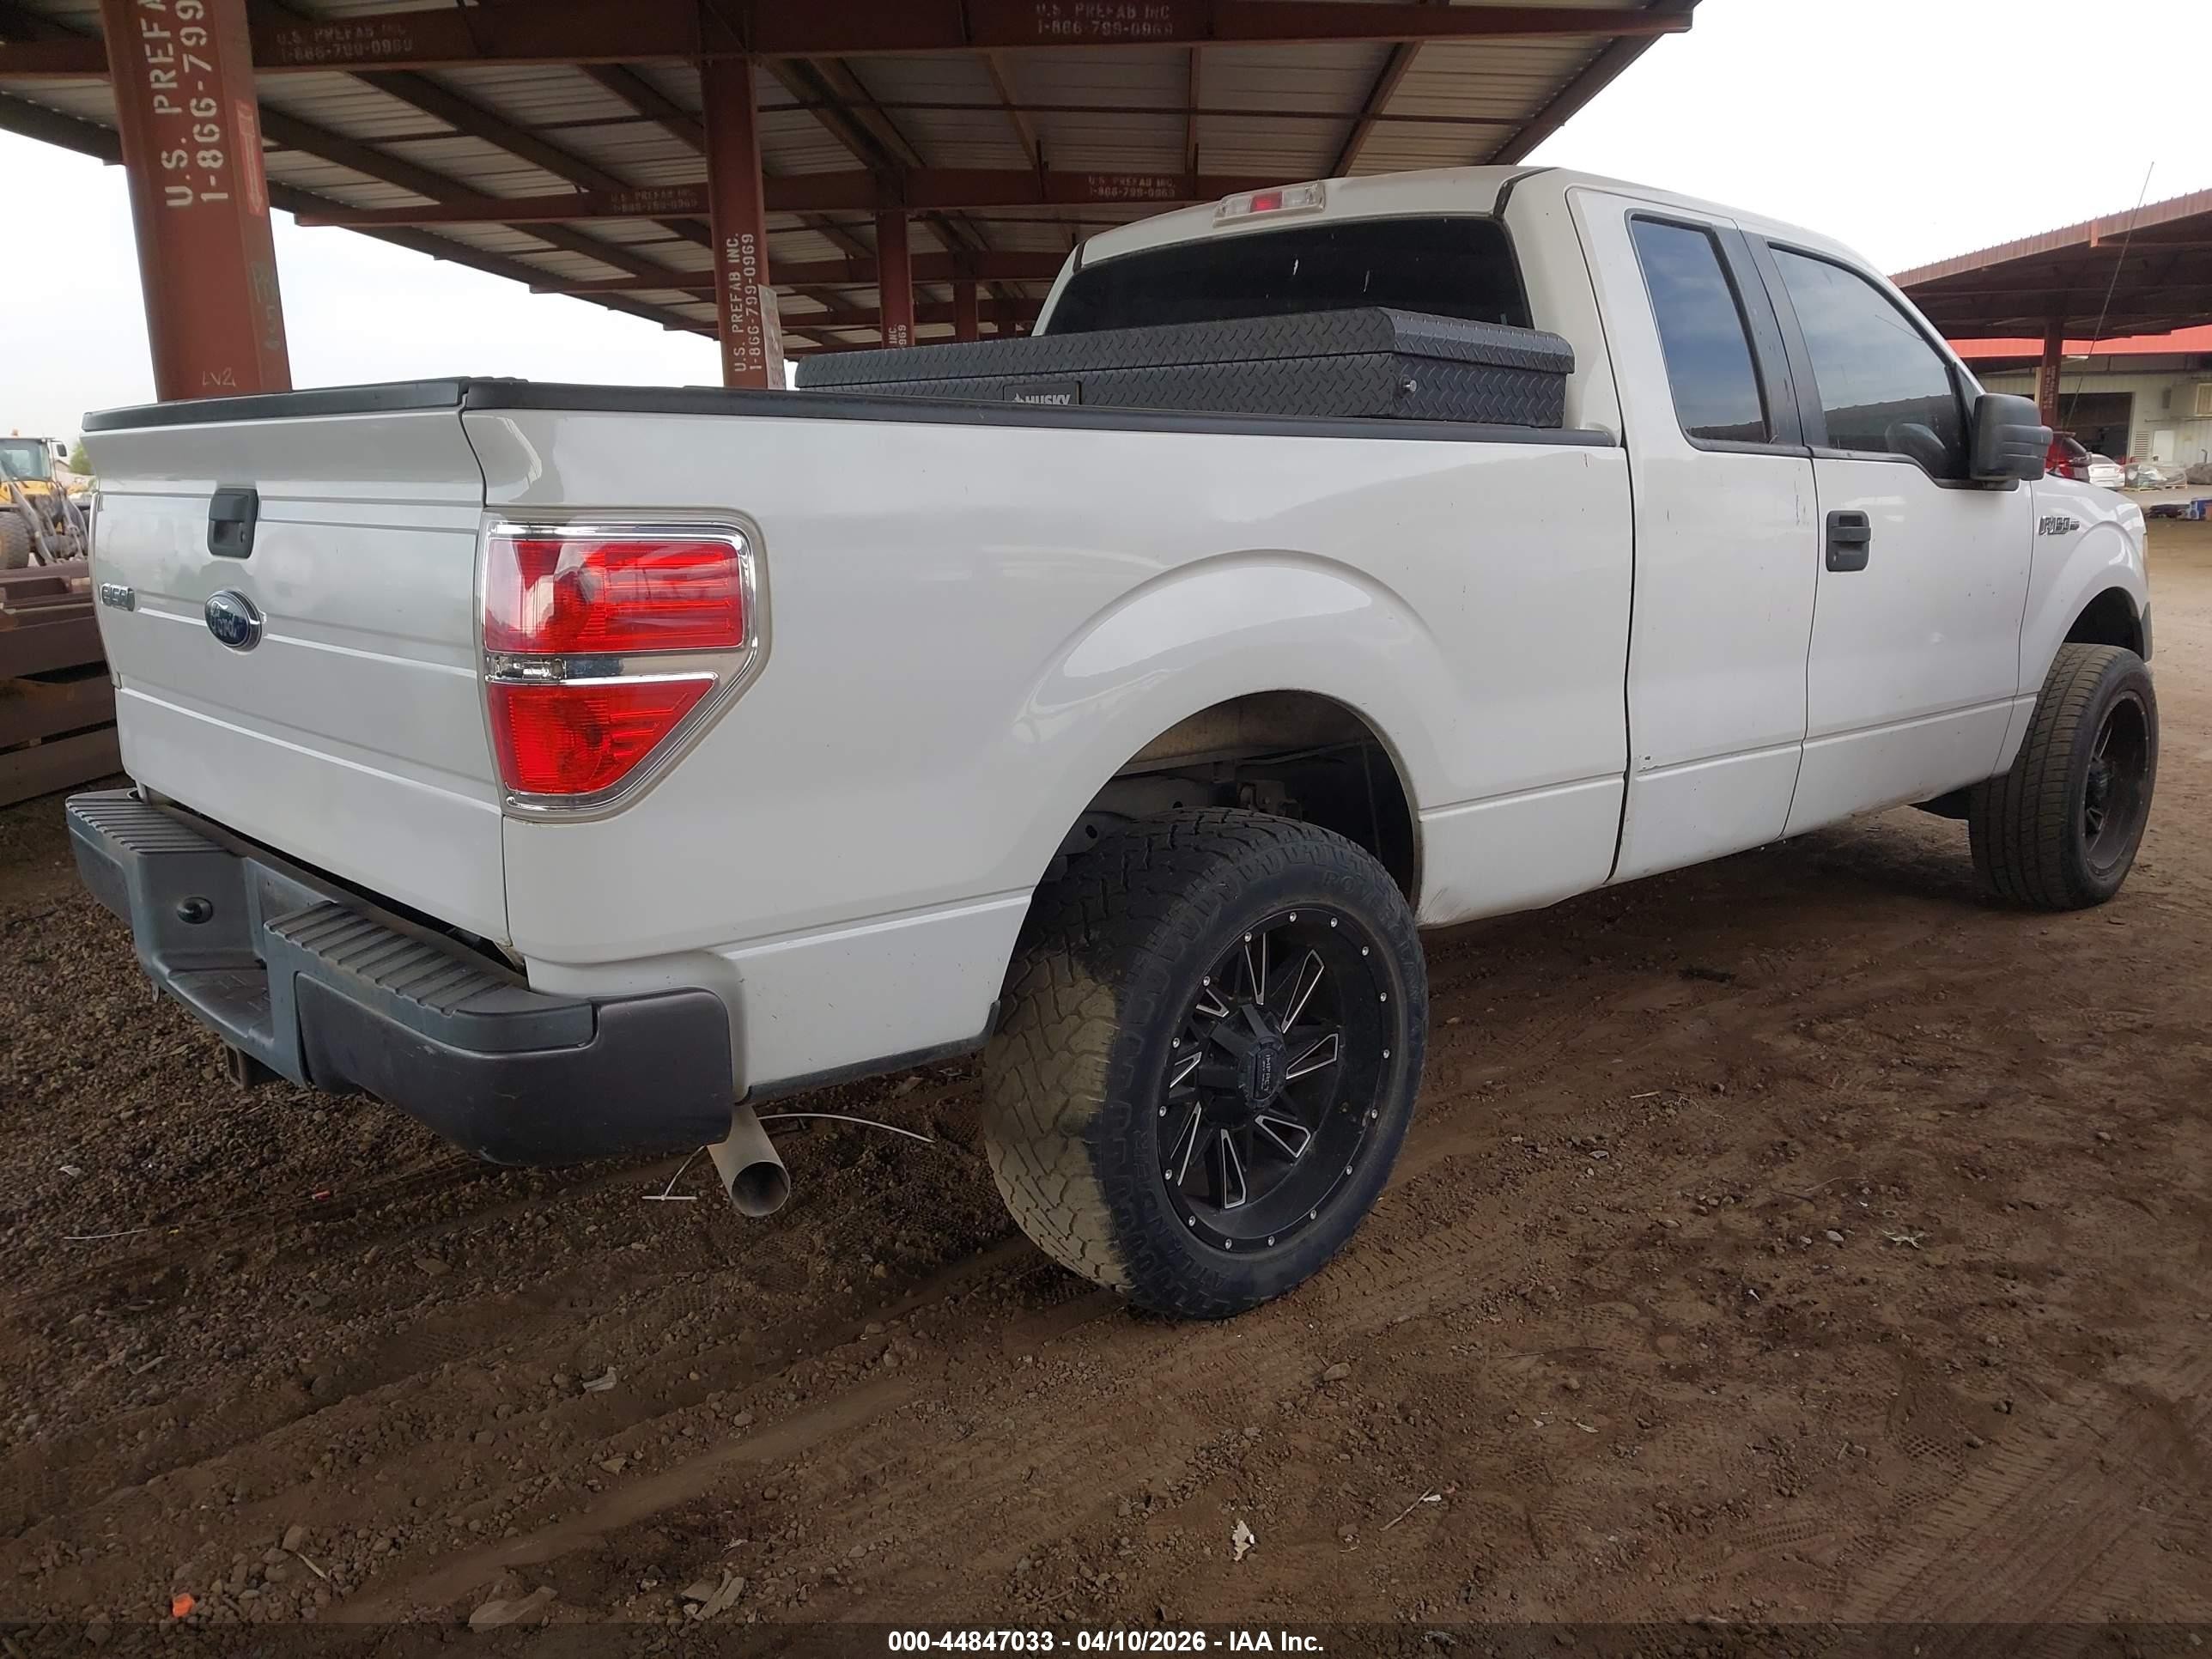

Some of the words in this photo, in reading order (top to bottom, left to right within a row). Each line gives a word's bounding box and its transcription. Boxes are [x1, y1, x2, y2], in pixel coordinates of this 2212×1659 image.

[161, 137, 194, 206] U.S.
[726, 234, 740, 263] INC.
[728, 271, 744, 333] PREFAB
[741, 234, 763, 370] 1-866-799-0969
[733, 342, 747, 372] U.S.
